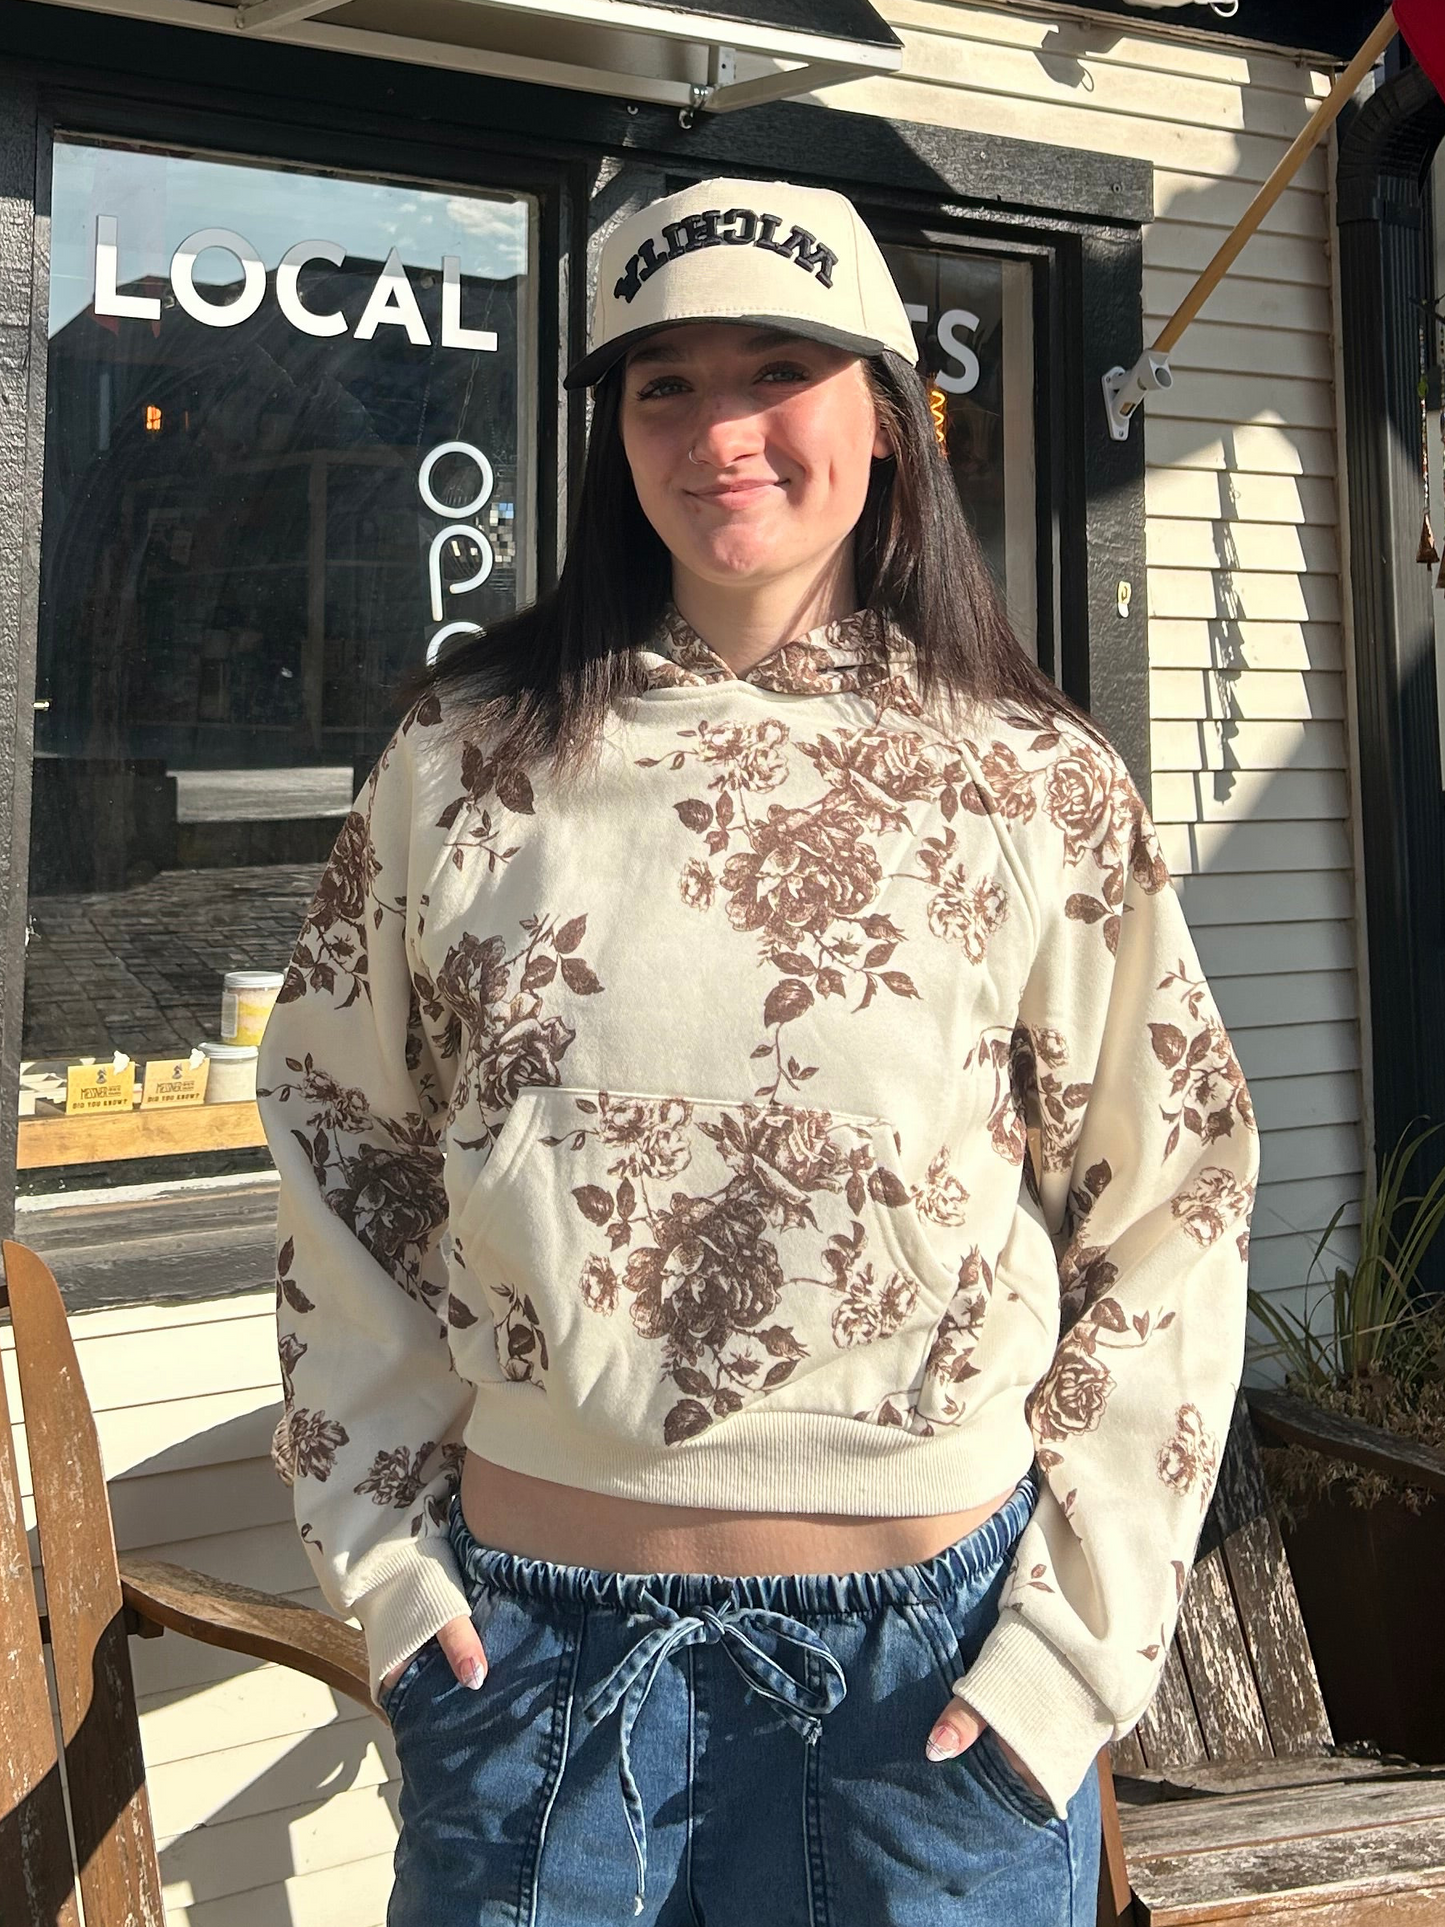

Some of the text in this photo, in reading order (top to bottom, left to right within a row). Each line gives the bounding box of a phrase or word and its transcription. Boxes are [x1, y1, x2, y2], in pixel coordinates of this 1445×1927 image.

[94, 214, 498, 352] LOCAL
[613, 208, 839, 303] WICHITA
[903, 302, 980, 394] S
